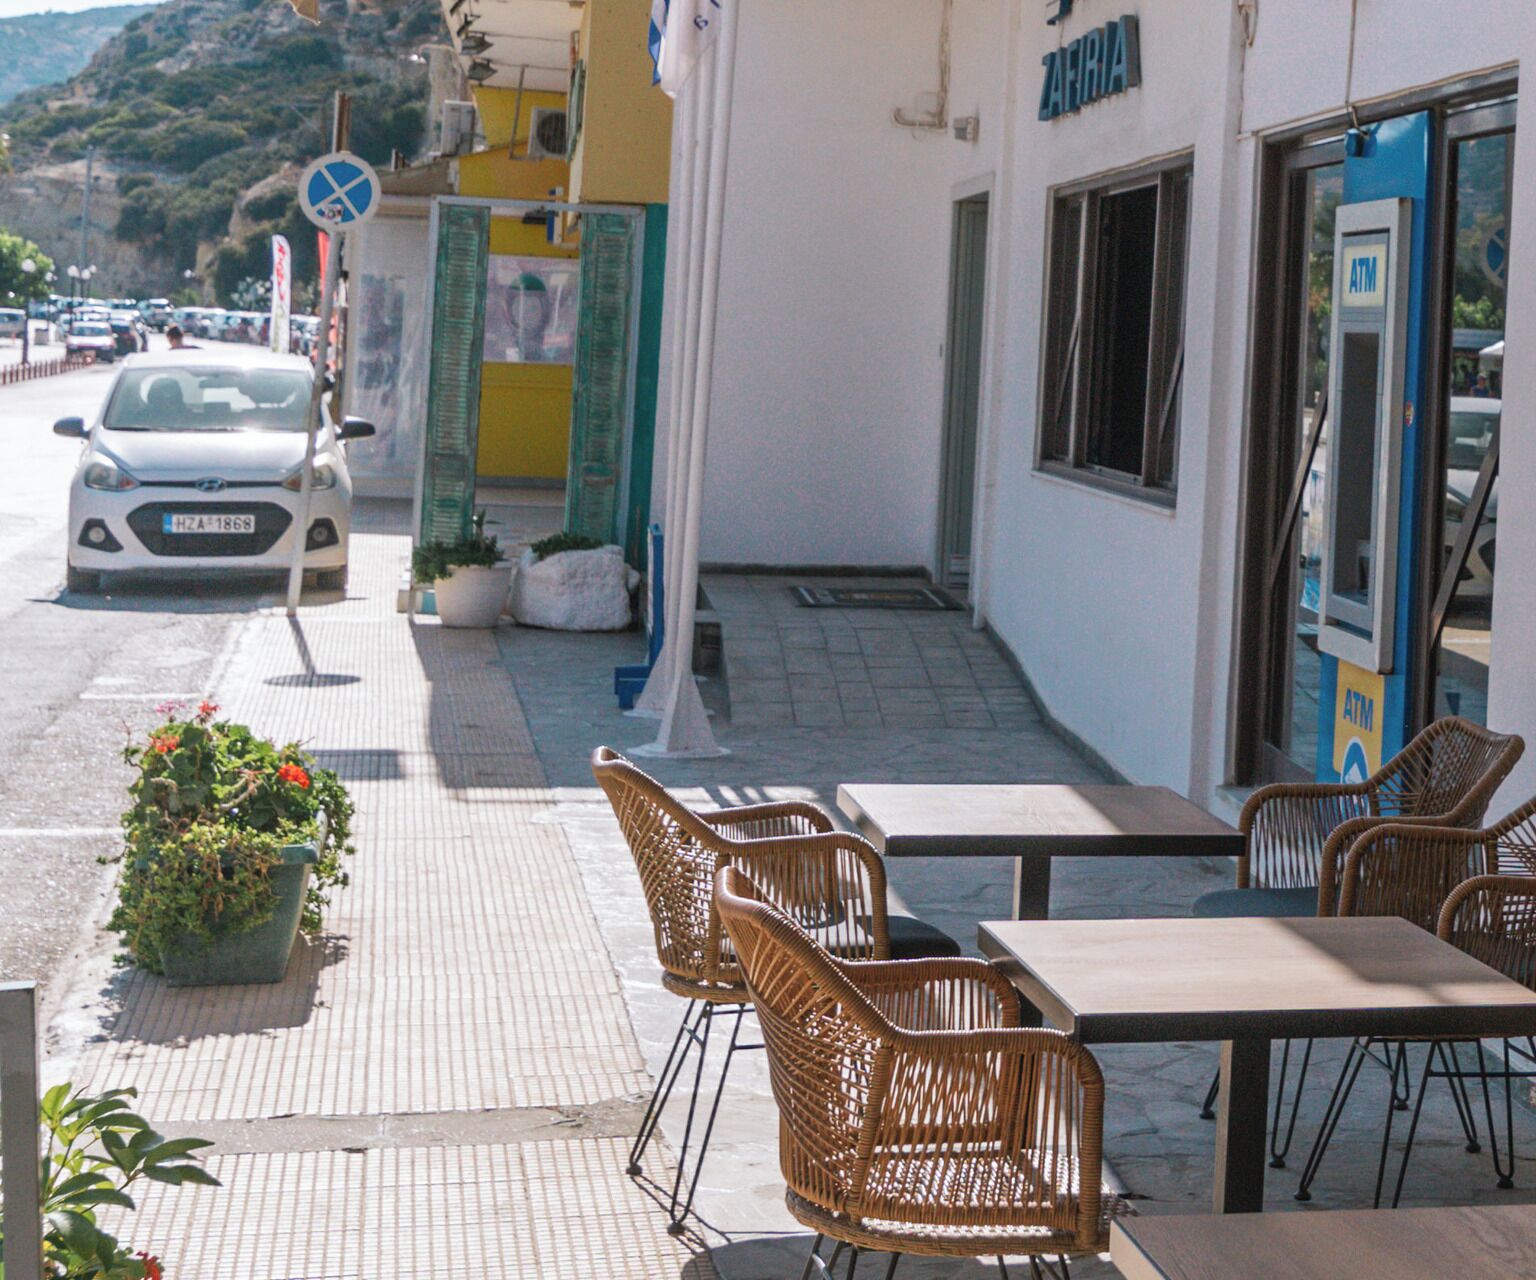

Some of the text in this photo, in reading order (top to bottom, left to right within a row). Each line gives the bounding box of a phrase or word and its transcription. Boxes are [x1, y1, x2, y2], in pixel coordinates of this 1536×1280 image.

[1038, 15, 1141, 121] ZAFIRIA
[1349, 256, 1377, 294] ATM
[1343, 687, 1374, 733] ATM
